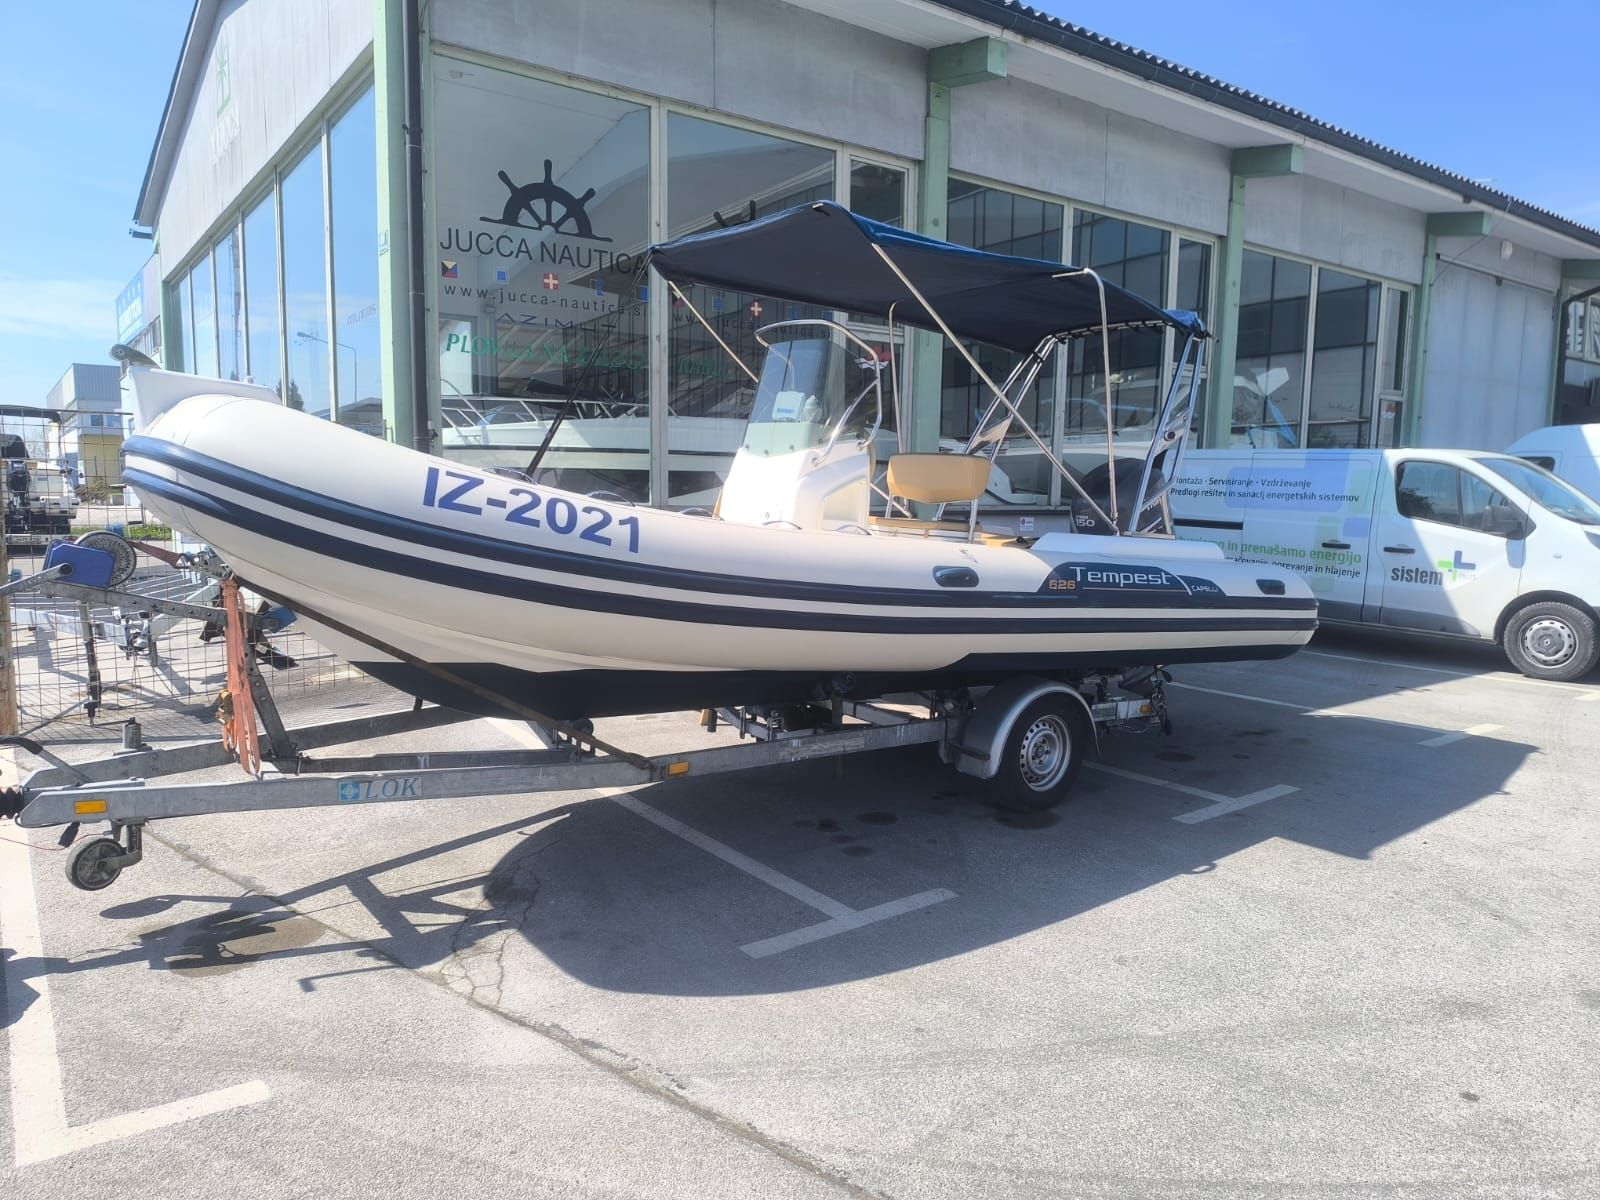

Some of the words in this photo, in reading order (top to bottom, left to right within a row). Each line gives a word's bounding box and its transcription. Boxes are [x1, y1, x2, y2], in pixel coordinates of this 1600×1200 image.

[440, 227, 533, 261] JUCCA
[540, 240, 649, 277] NAUTICA
[1209, 477, 1254, 489] Servisiranje
[1261, 479, 1312, 490] Vzdrževanje
[1170, 487, 1201, 498] Predlogi
[1201, 488, 1228, 498] rešitev
[1228, 489, 1236, 498] in
[1237, 490, 1265, 501] sanacij
[1266, 491, 1317, 502] energetskih
[1318, 493, 1360, 502] sistemov
[423, 467, 640, 554] IZ-2021
[1075, 518, 1096, 527] 150
[1227, 540, 1238, 551] in
[1241, 541, 1306, 559] prenašamo
[1309, 550, 1362, 566] energijo
[1069, 566, 1172, 587] Tempest
[1315, 564, 1324, 573] in
[1324, 566, 1361, 578] hlajenje
[1391, 566, 1443, 586] sistem
[1049, 579, 1076, 590] 626
[365, 777, 419, 799] LOK
